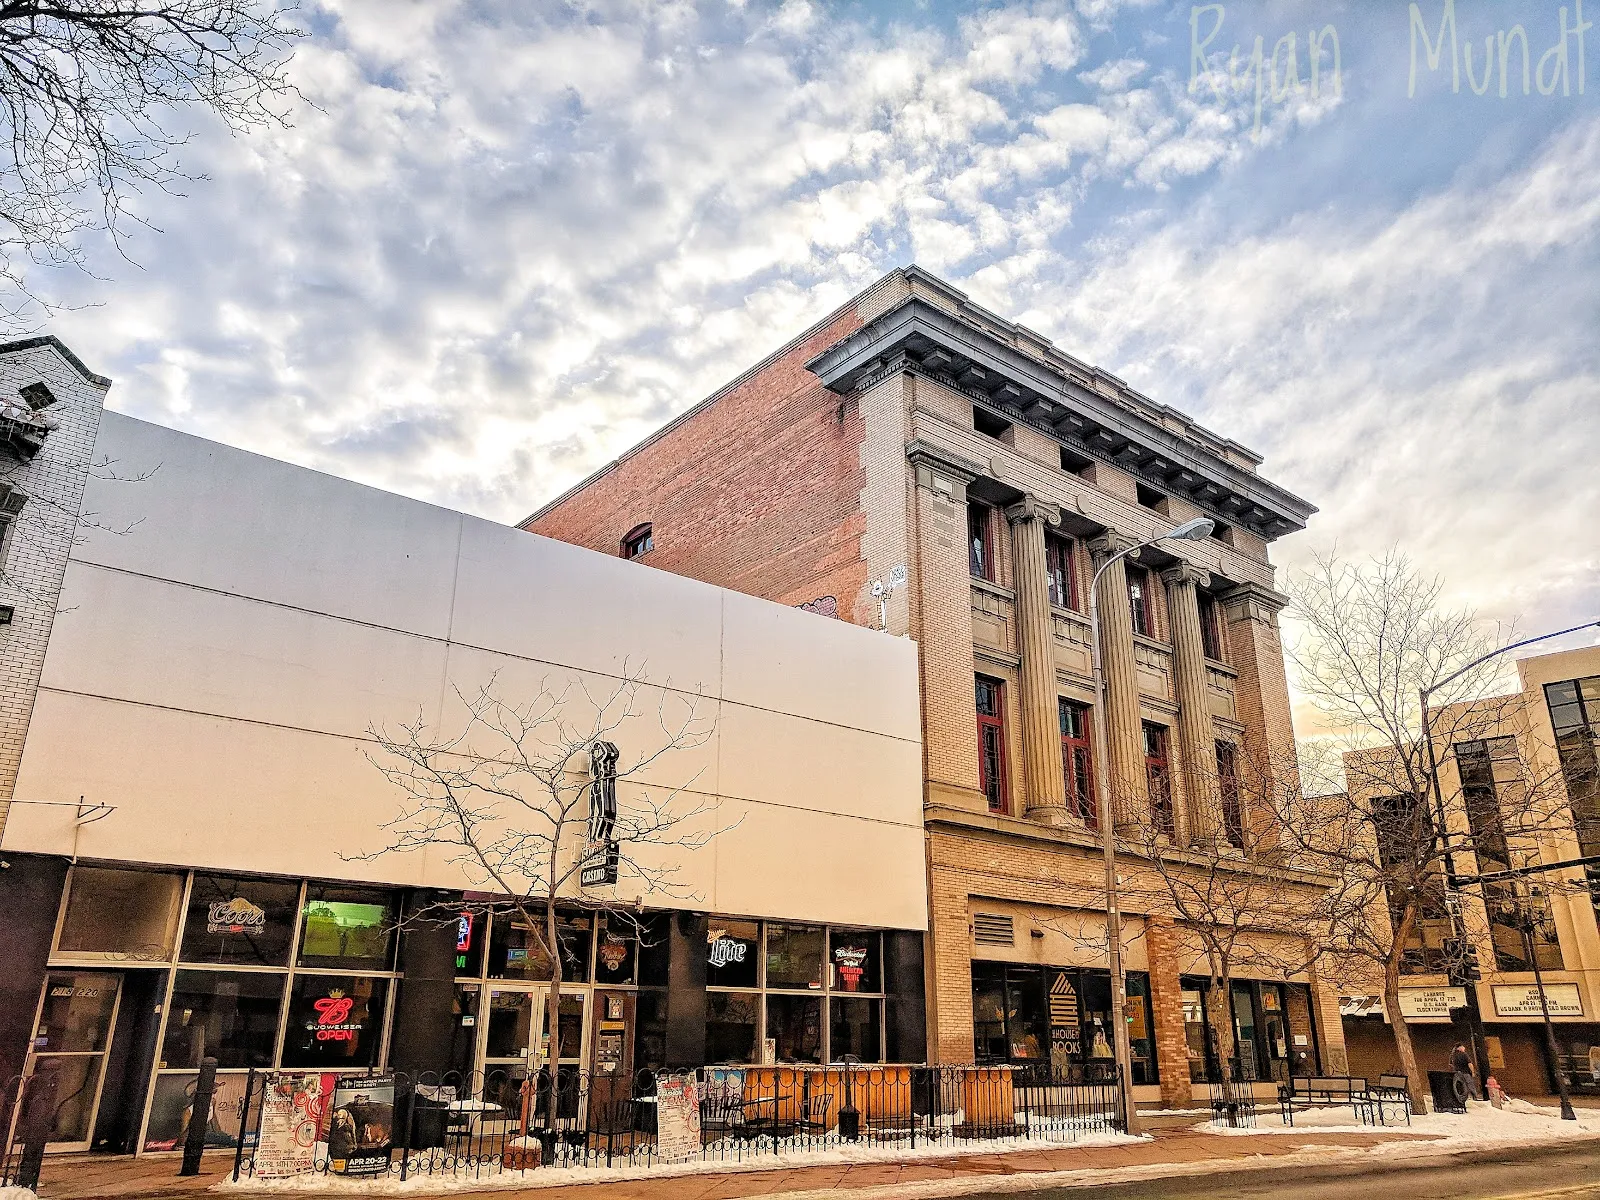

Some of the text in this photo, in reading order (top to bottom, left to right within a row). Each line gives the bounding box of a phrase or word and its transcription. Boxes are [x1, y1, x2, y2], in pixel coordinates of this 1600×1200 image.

[582, 867, 605, 884] CASINO
[208, 902, 266, 925] Coors
[708, 939, 747, 967] Lite
[77, 988, 99, 997] 220
[316, 1030, 353, 1040] OPEN
[1056, 1029, 1076, 1039] HOUSE
[1052, 1041, 1080, 1054] BOOKS
[146, 1140, 175, 1149] Budweiser
[365, 1156, 387, 1165] 20-22
